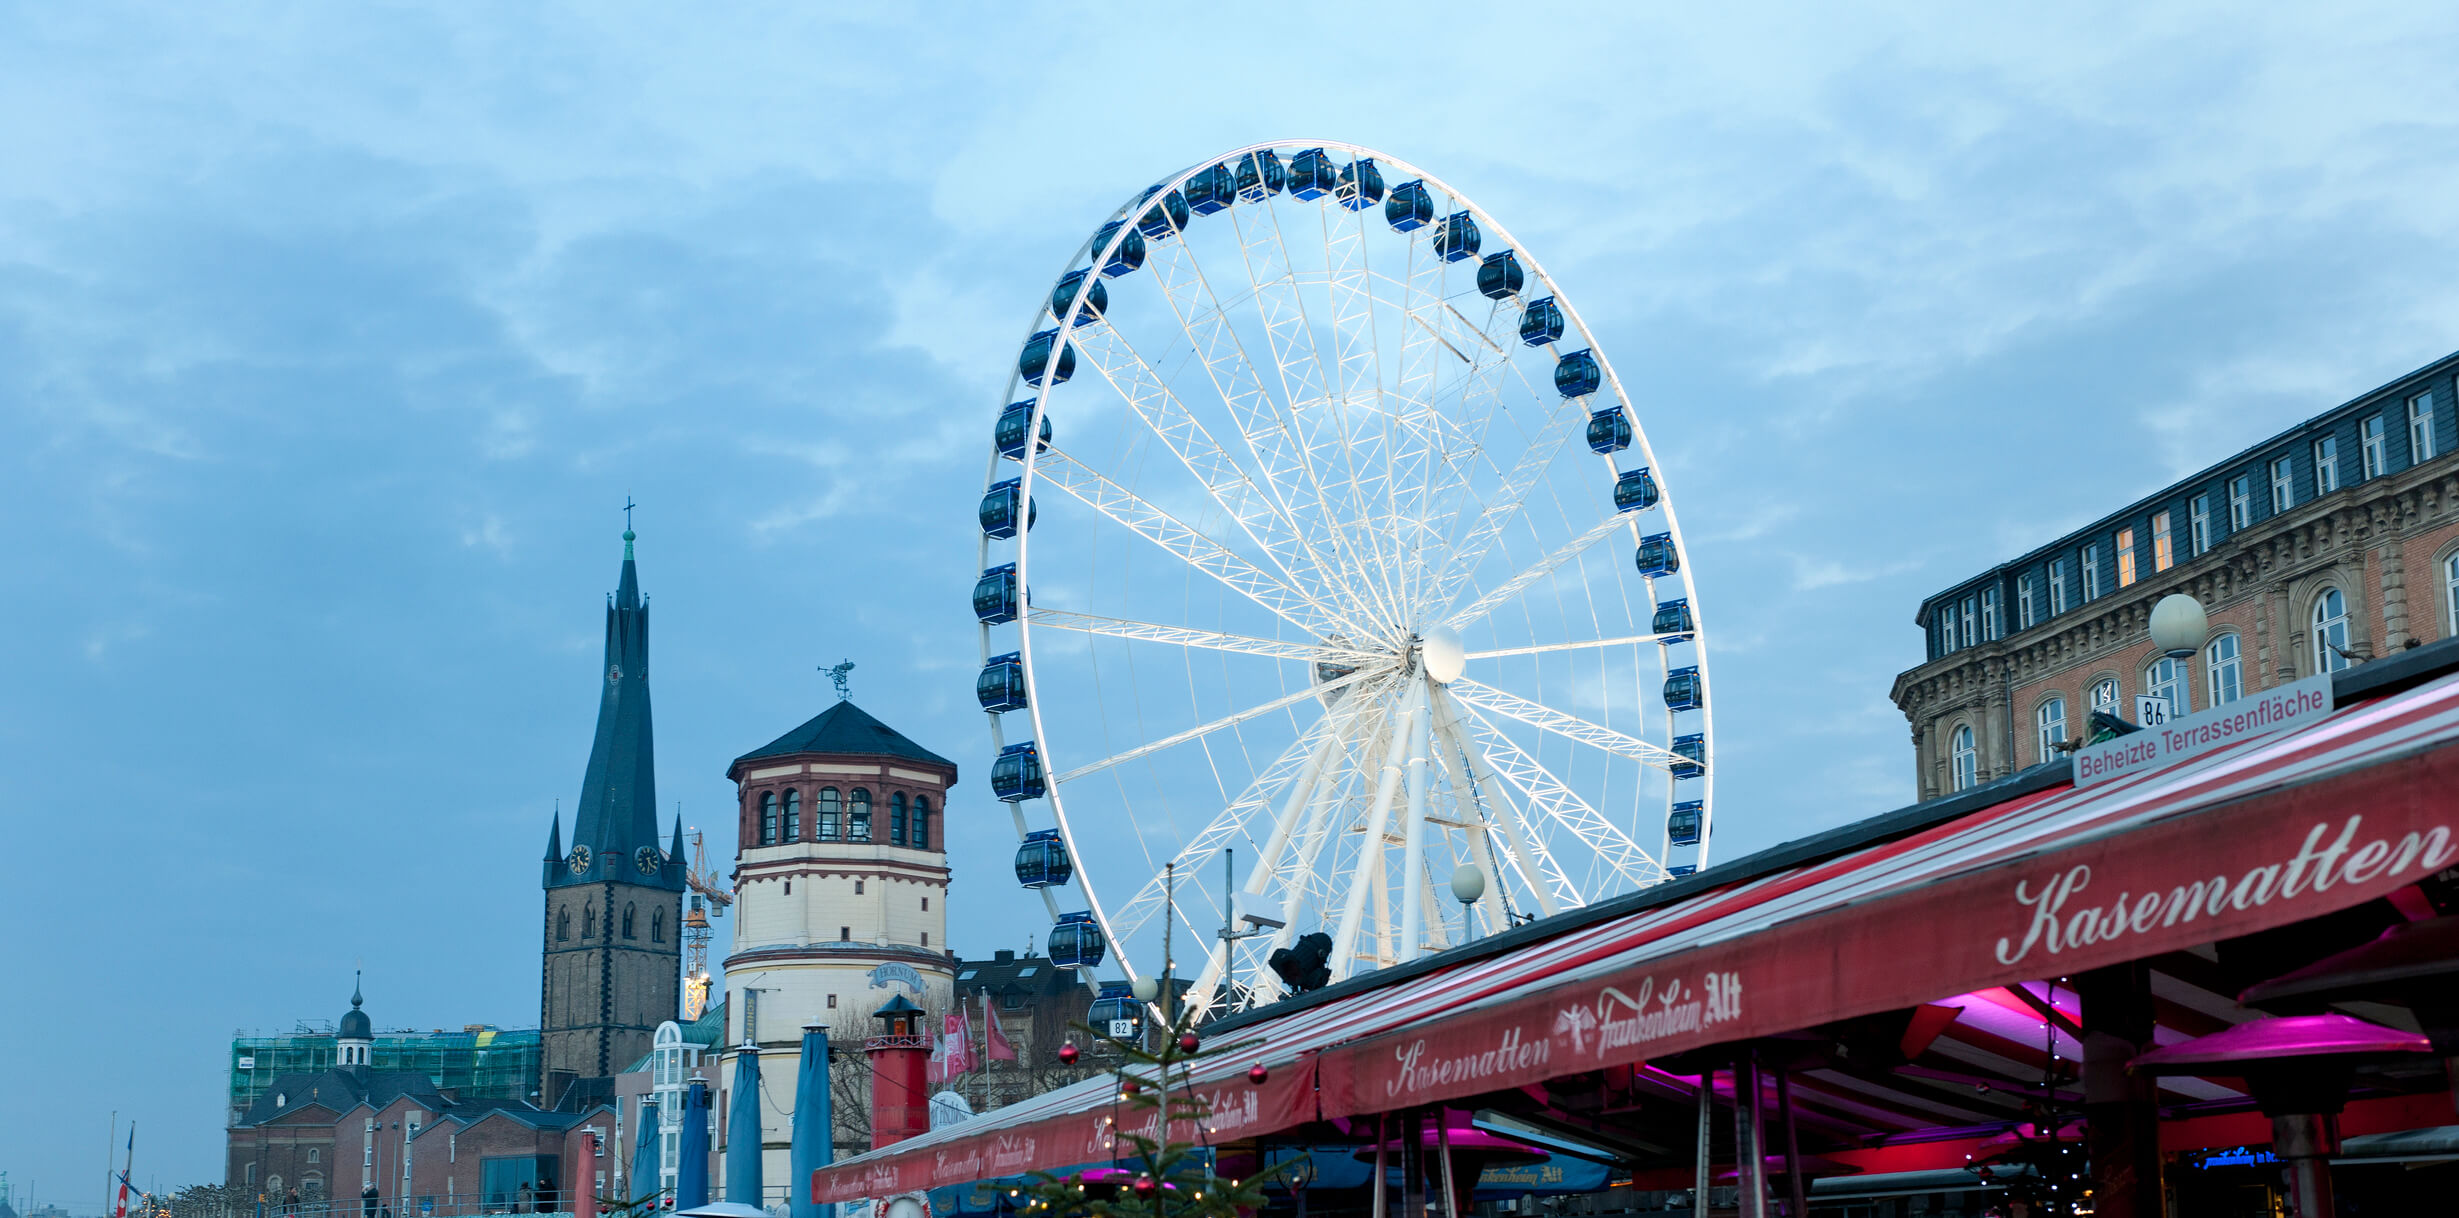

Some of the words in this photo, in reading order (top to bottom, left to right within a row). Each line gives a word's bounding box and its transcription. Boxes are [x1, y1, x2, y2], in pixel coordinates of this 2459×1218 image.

[2080, 740, 2156, 779] Beheizte
[2162, 690, 2323, 752] Terrassenfläche
[2144, 701, 2164, 726] 86
[1995, 814, 2457, 965] Kasematten
[1115, 1022, 1127, 1034] 82
[1387, 1026, 1549, 1097] Kasematten
[1597, 976, 1703, 1060] Frankenheim
[1703, 971, 1742, 1029] Alt
